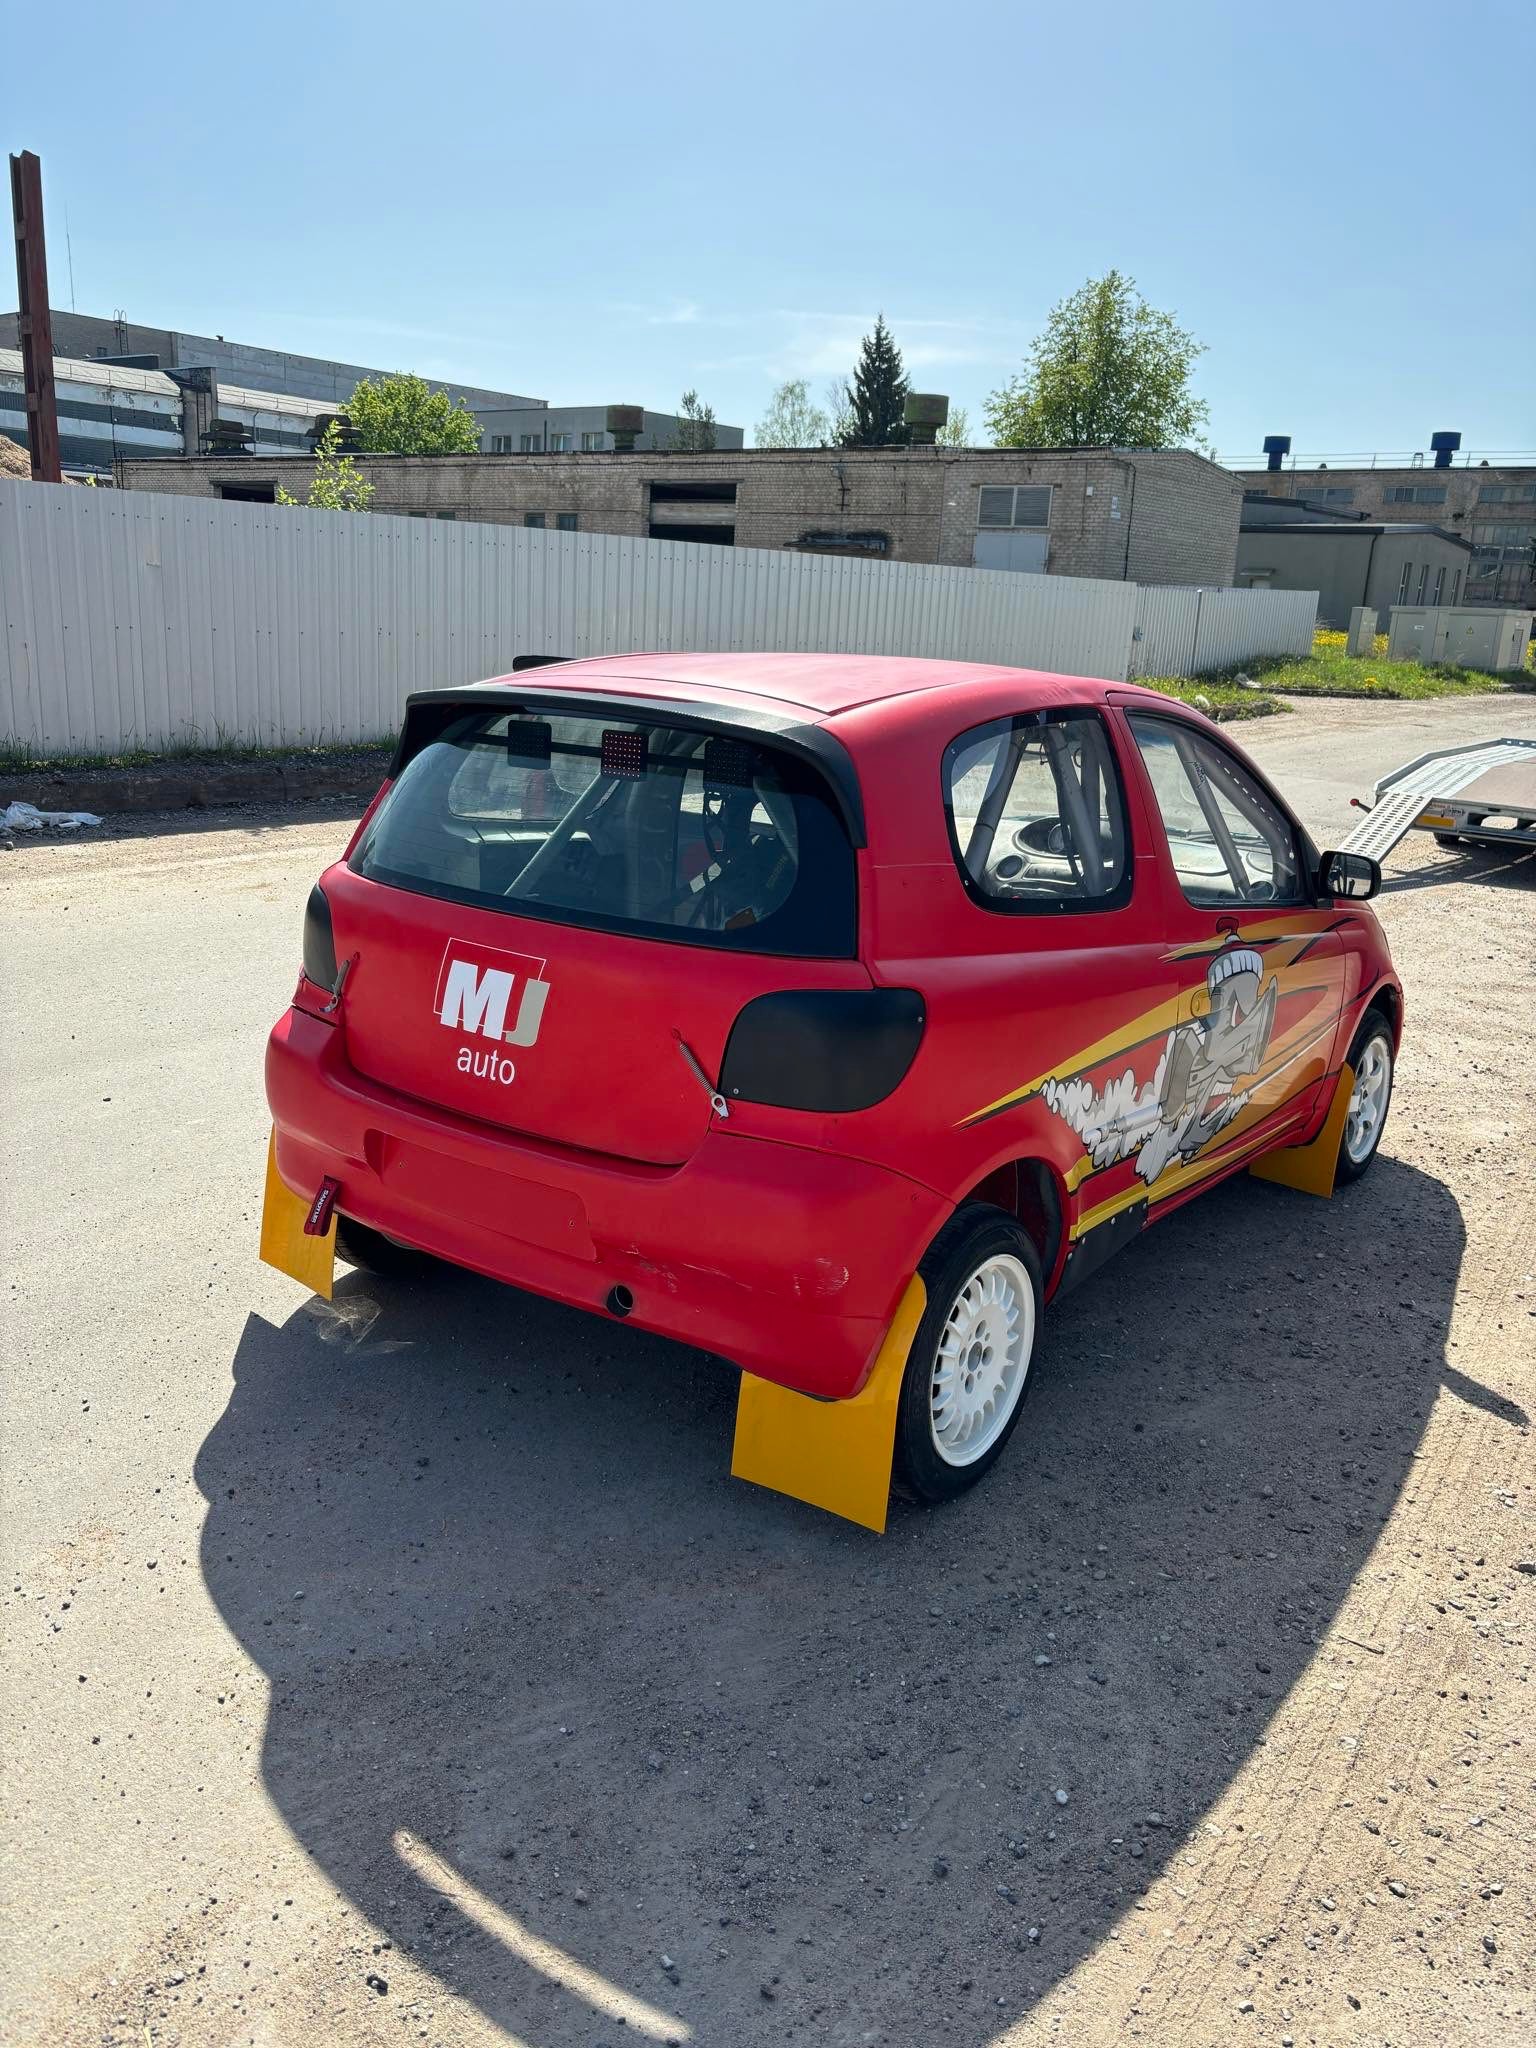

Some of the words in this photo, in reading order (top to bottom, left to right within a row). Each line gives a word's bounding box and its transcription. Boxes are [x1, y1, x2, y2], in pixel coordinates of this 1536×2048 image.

[440, 959, 550, 1047] MJ
[457, 1047, 515, 1085] auto
[311, 1189, 329, 1224] SANDTLER
